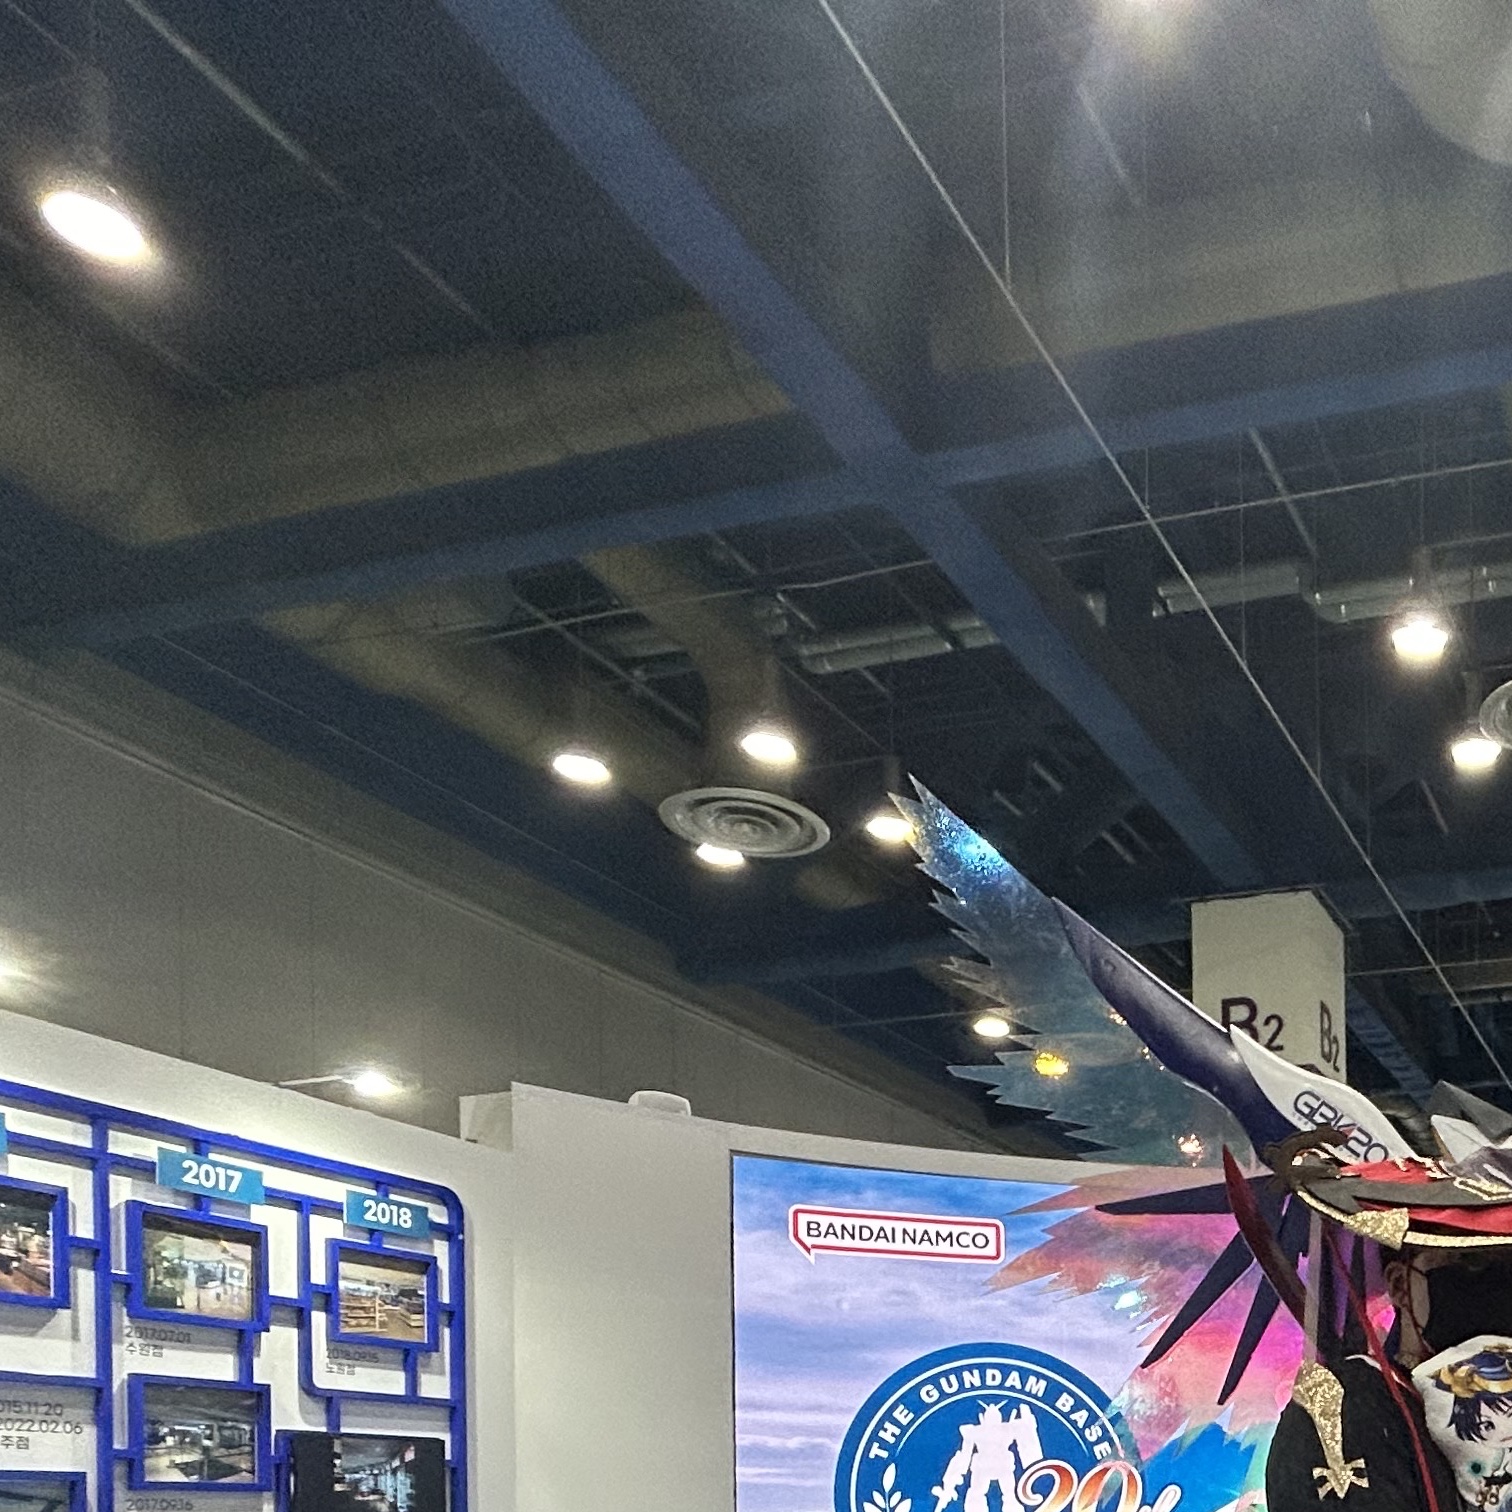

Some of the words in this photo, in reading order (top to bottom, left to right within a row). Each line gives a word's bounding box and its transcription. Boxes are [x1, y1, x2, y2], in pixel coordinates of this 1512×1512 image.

[182, 1160, 242, 1193] 2017
[363, 1200, 413, 1228] 2018
[806, 1221, 896, 1243] BANDAI
[902, 1228, 990, 1249] NAMCO
[869, 1404, 915, 1461] THE
[919, 1368, 1047, 1403] GUNDAM
[1054, 1392, 1112, 1460] BASE
